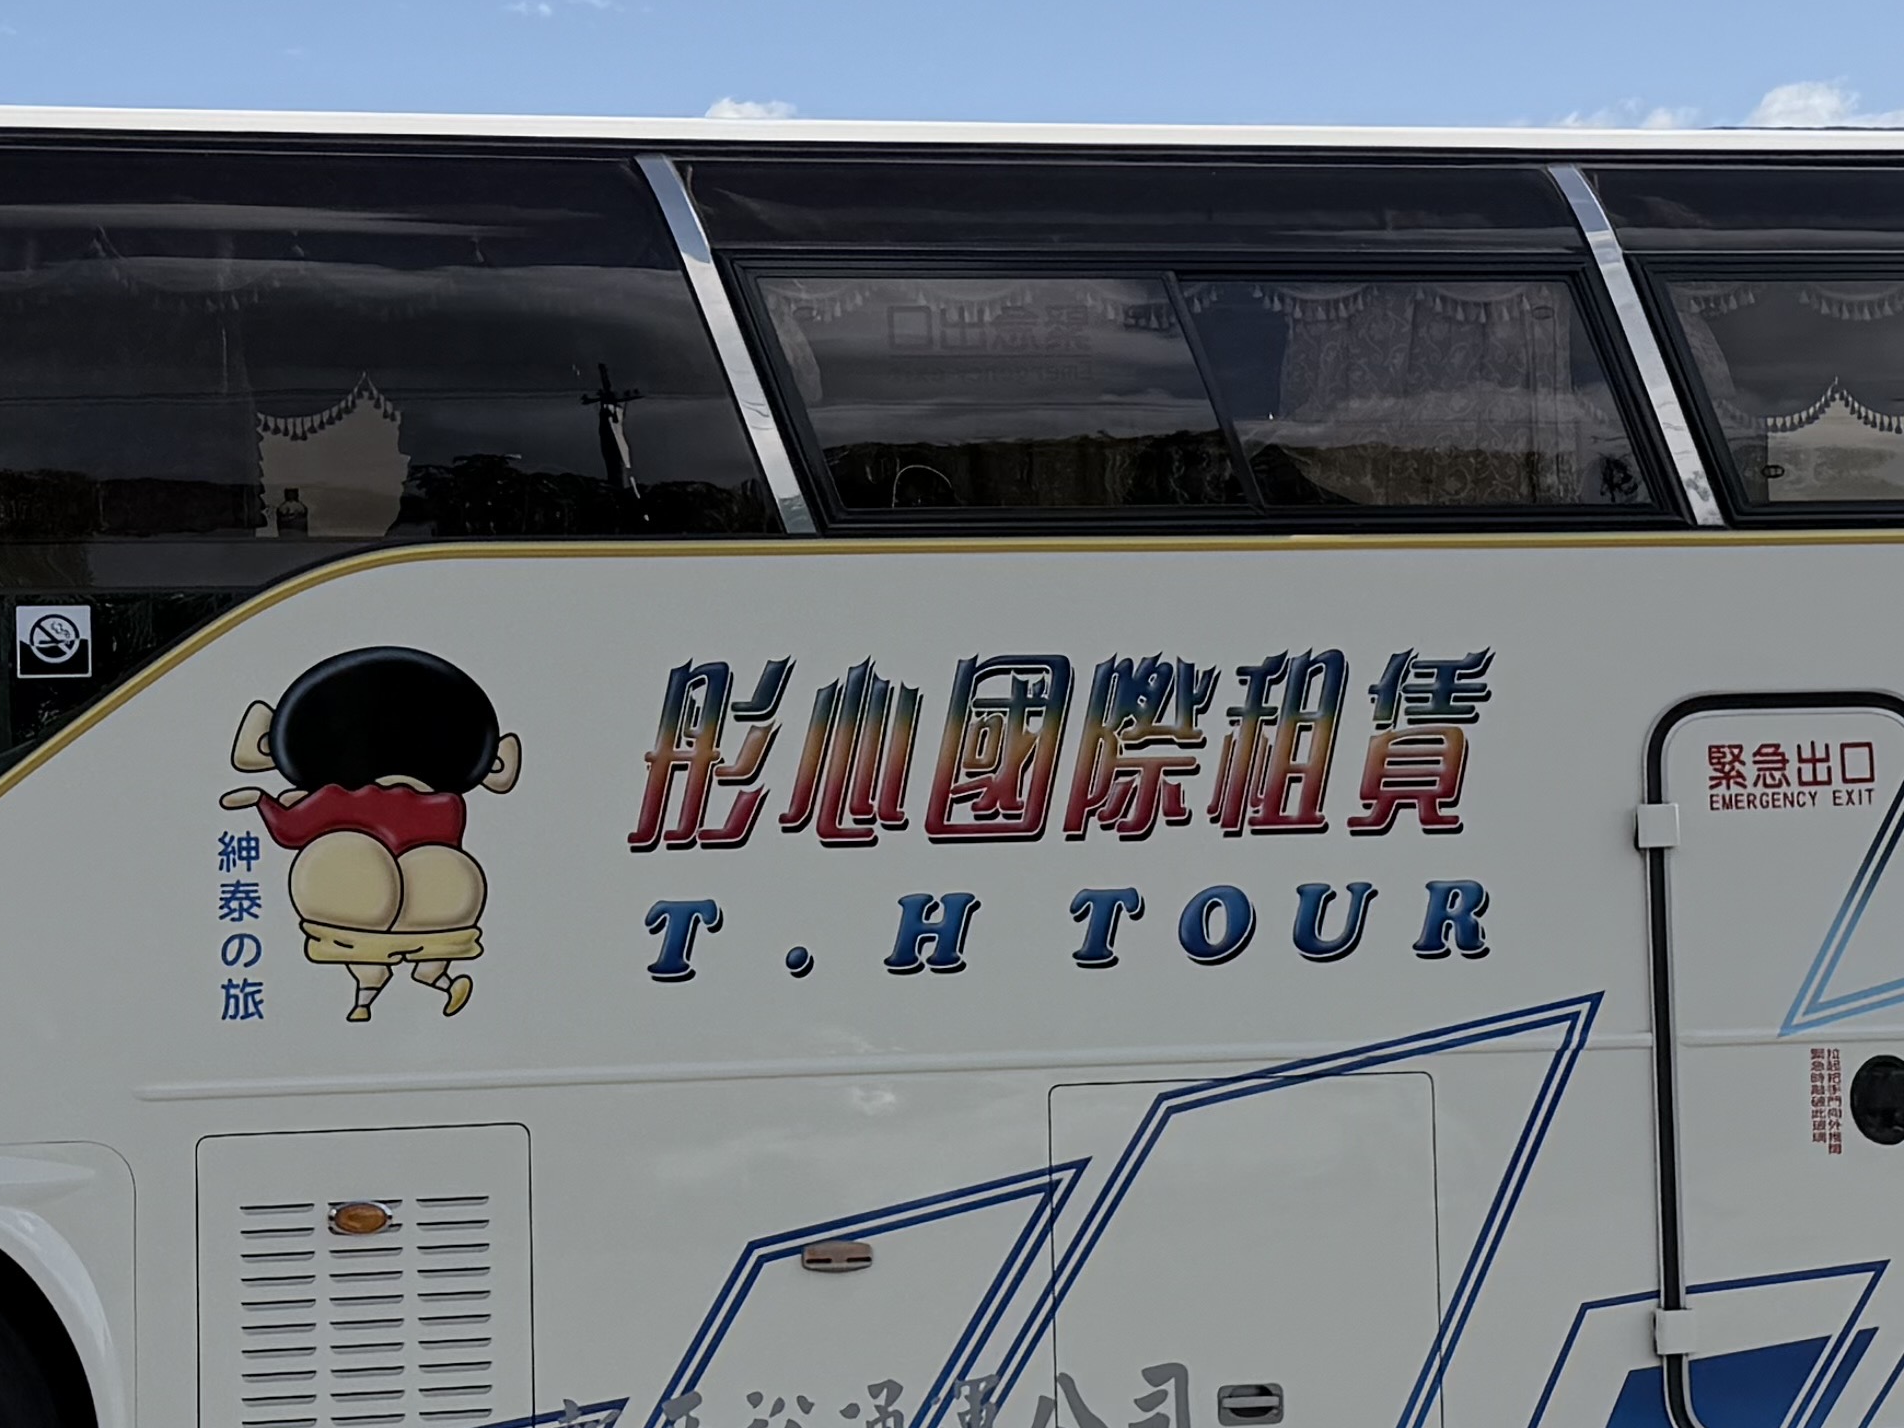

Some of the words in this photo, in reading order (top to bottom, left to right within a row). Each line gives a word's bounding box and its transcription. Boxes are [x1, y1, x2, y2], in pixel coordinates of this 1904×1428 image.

[1708, 740, 1875, 790] 緊急出口
[1709, 791, 1819, 811] EMERGENCY
[1832, 788, 1875, 807] EXIT
[217, 830, 265, 1021] 紳泰の旅
[1069, 878, 1492, 969] TOUR
